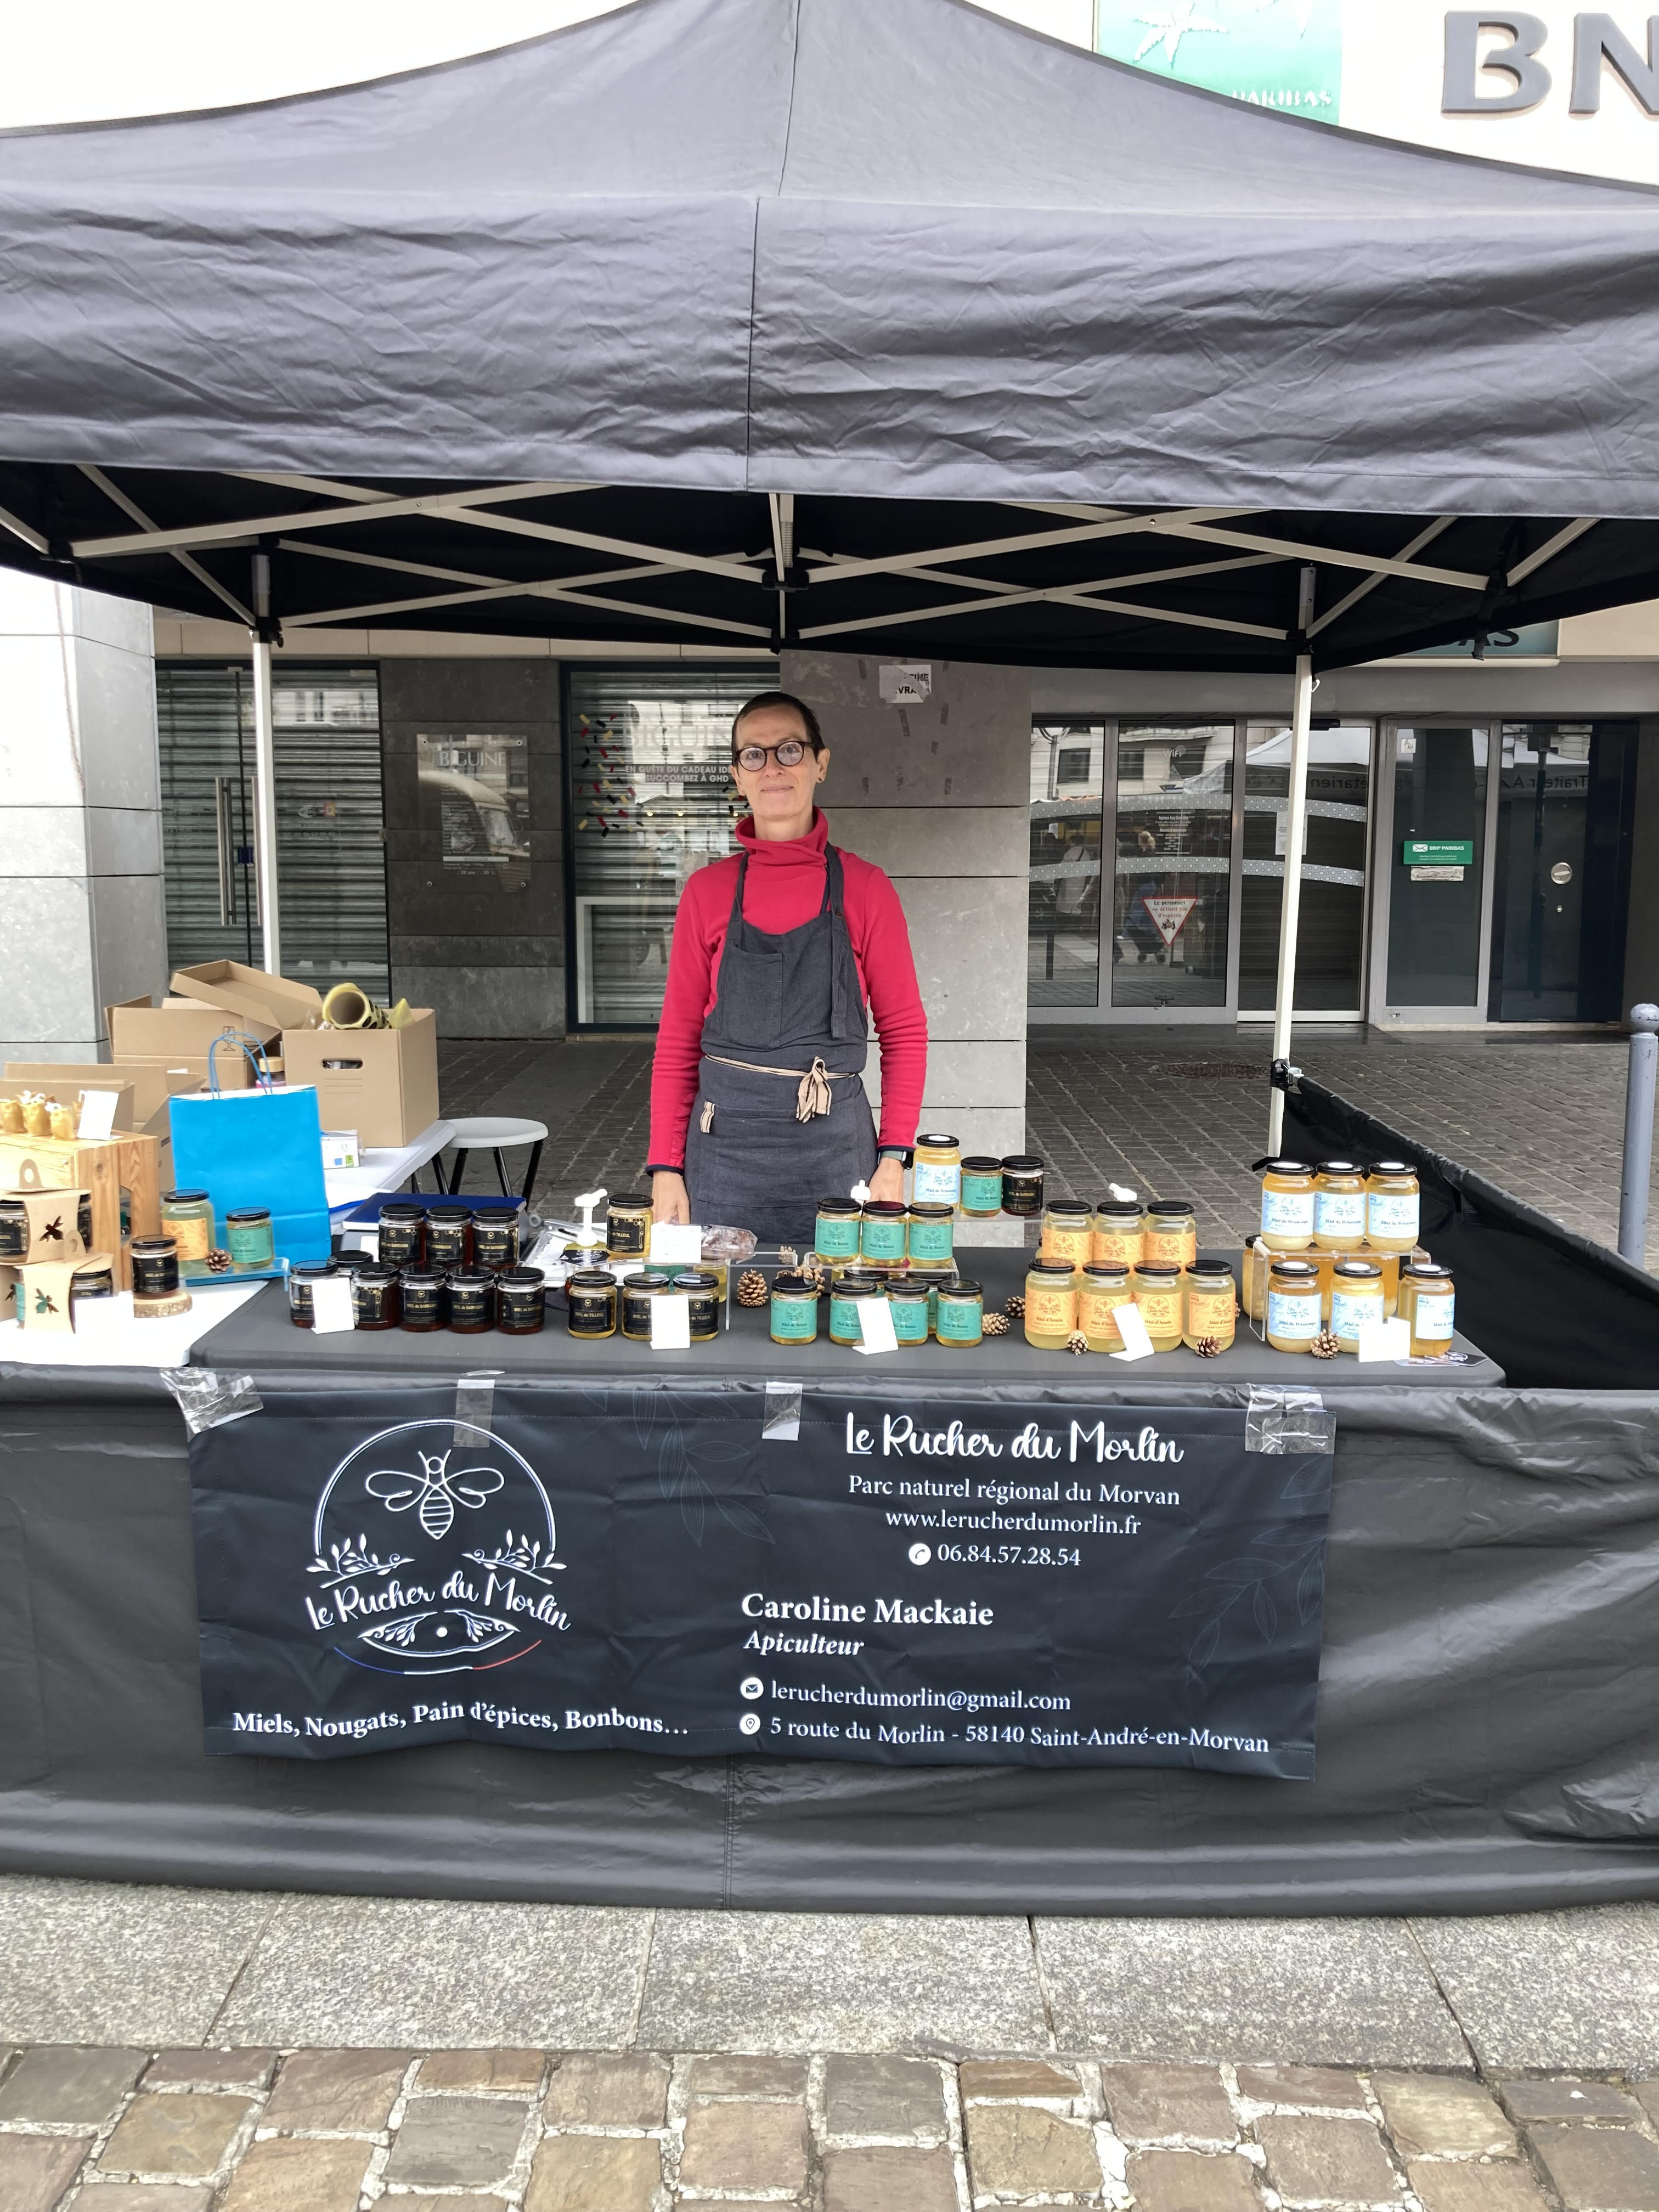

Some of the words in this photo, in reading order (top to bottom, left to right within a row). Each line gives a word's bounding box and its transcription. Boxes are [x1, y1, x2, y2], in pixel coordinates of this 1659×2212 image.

[1441, 10, 1659, 115] BN
[624, 724, 733, 748] BIGUIN
[439, 751, 506, 766] BGUINE
[639, 765, 665, 773] QUÊTE
[700, 773, 707, 782] À
[846, 1412, 874, 1455] Le
[882, 1413, 1003, 1457] Rucher
[1011, 1422, 1062, 1459] du
[1069, 1420, 1184, 1463] Morlin
[849, 1475, 893, 1495] Parc
[899, 1478, 970, 1497] naturel
[977, 1479, 1059, 1505] régional
[1065, 1481, 1092, 1502] du
[1098, 1484, 1180, 1505] Morvan
[885, 1509, 1142, 1534] www.lerucherdumorlin.fr
[937, 1544, 1081, 1566] 06.84.57.28.54
[304, 1595, 334, 1630] Le
[333, 1577, 436, 1624] Rucher
[442, 1570, 479, 1602] du
[483, 1573, 572, 1633] Morlin
[741, 1593, 866, 1623] Caroline
[873, 1598, 994, 1626] Mackaie
[742, 1630, 865, 1656] Apiculteur
[772, 1680, 1071, 1713] lerucherdumorlin@gmail.com
[232, 1712, 300, 1737] Miels,
[304, 1712, 407, 1739] Nougats,
[412, 1701, 465, 1723] Pain
[470, 1701, 558, 1731] d'épices,
[771, 1717, 782, 1734] 5
[788, 1722, 840, 1738] route
[845, 1721, 871, 1740] du
[877, 1724, 945, 1744] Morlin
[966, 1725, 1025, 1743] 58140
[1030, 1726, 1269, 1752] Saint-André-en-Morvan
